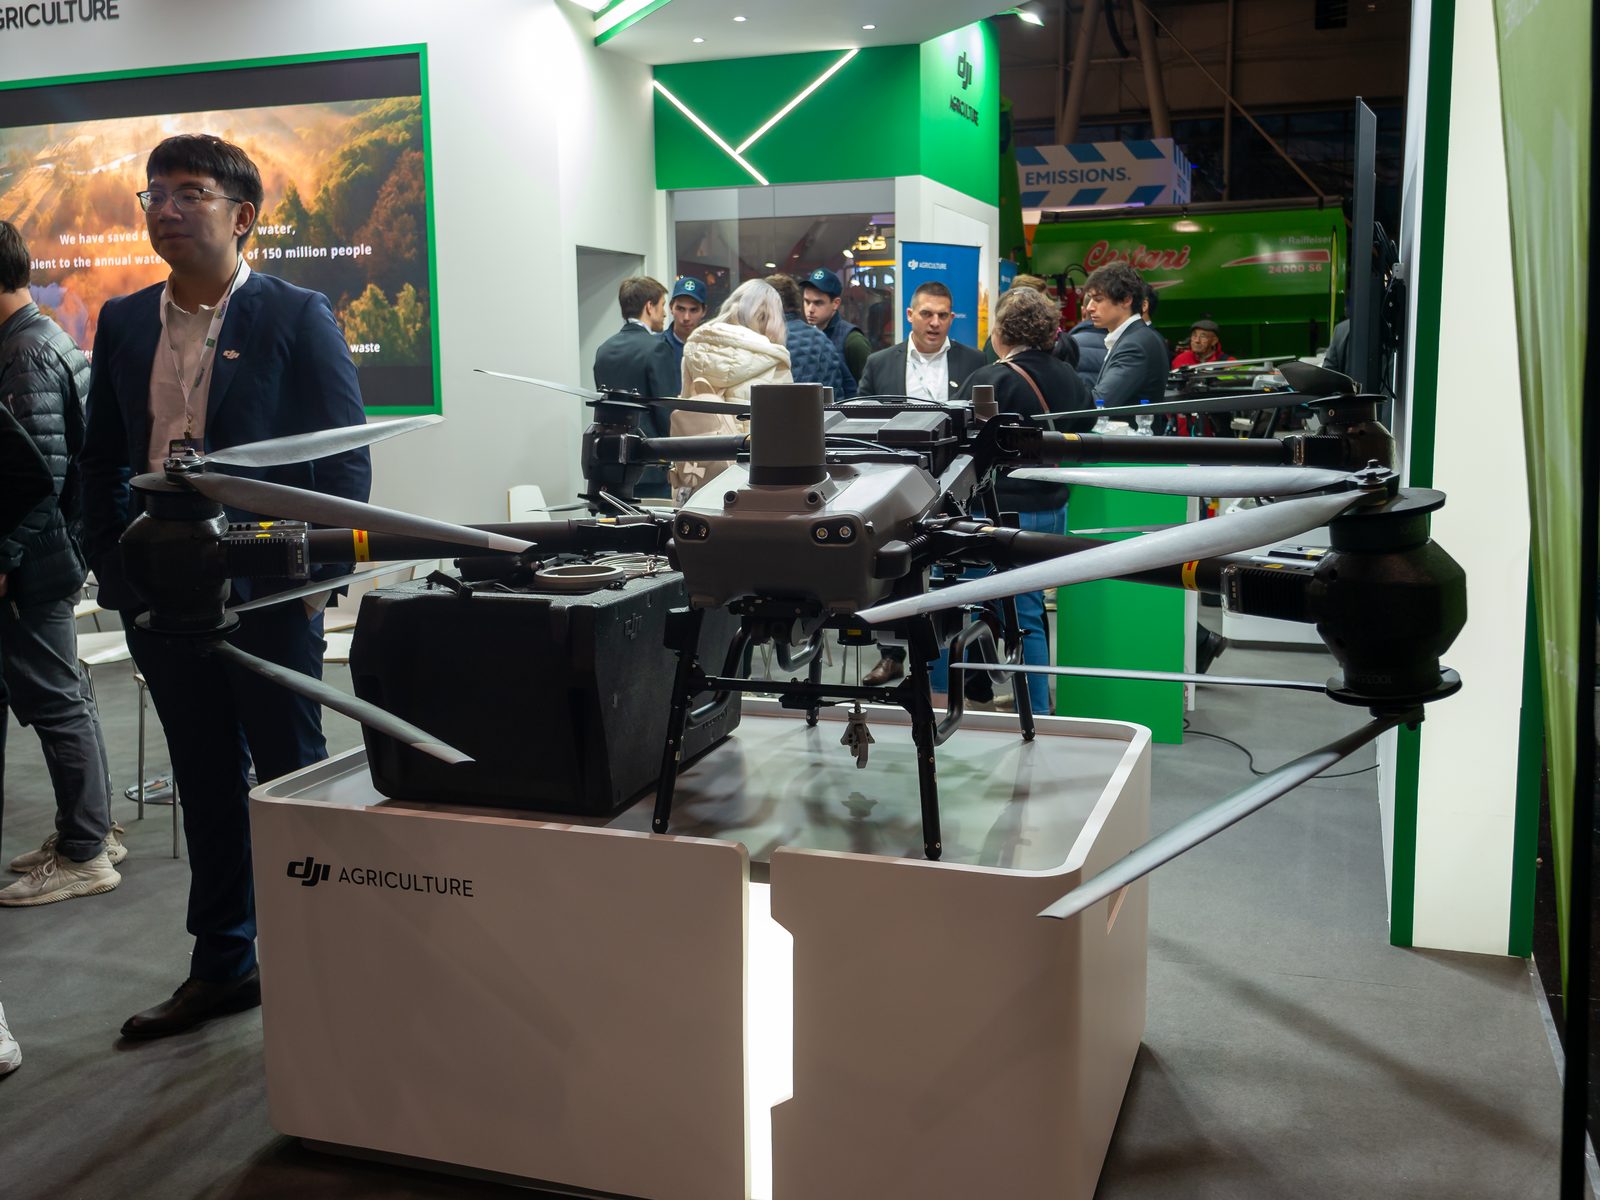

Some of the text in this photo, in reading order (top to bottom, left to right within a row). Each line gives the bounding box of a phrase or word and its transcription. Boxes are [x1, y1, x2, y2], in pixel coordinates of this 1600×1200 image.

[0, 0, 120, 30] RICULTURE
[1025, 167, 1132, 186] EMISSIONS.
[60, 233, 76, 245] We
[79, 232, 104, 244] have
[107, 230, 138, 243] saved
[257, 224, 296, 236] water,
[247, 243, 372, 260] of 150 million people
[30, 257, 56, 270] alent
[59, 258, 70, 269] to
[73, 256, 91, 268] the
[95, 254, 131, 267] annual
[350, 343, 381, 353] waste
[338, 867, 474, 897] AGRICULTURE
